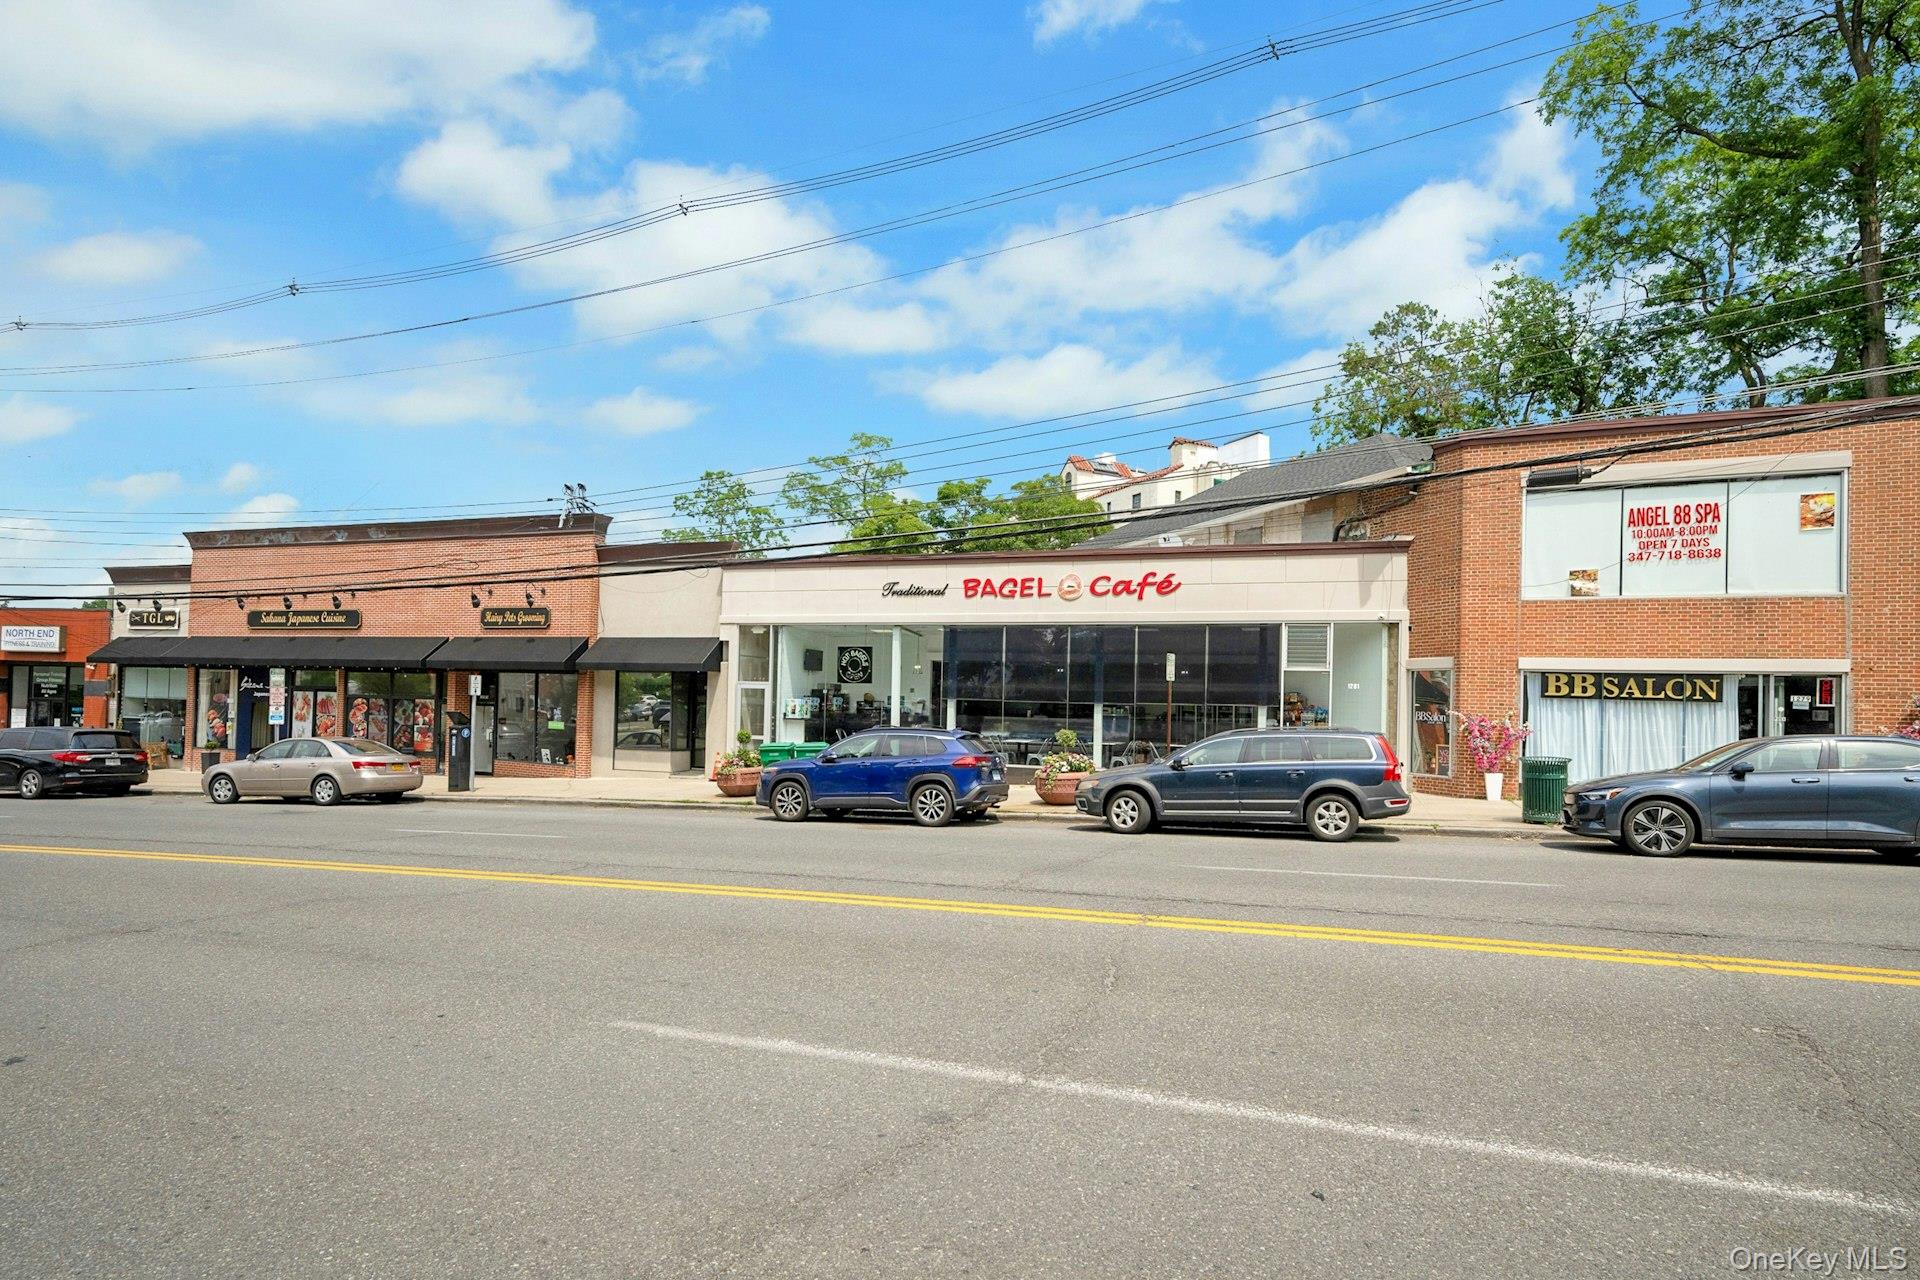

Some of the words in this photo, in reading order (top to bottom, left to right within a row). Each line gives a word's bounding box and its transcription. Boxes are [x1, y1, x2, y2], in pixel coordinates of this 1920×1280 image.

[1628, 506, 1670, 528] ANGEL
[1673, 504, 1691, 525] 88
[1695, 502, 1721, 523] SPA
[1632, 525, 1718, 539] 10:00AM-8:00PM
[1638, 540, 1667, 550] OPEN
[1671, 539, 1678, 549] 7
[1681, 537, 1710, 548] DAYS
[1627, 548, 1721, 562] 347-718-8638
[881, 581, 949, 598] Traditional
[962, 577, 1052, 599] BAGEL
[1089, 572, 1182, 601] Café
[142, 612, 163, 624] TGL
[260, 612, 286, 624] Sakana
[286, 612, 320, 626] Japanese
[320, 611, 347, 623] Cuisine
[5, 629, 35, 638] NORTH
[37, 629, 55, 638] END
[1544, 673, 1596, 697] BB
[1603, 677, 1720, 700] SALON
